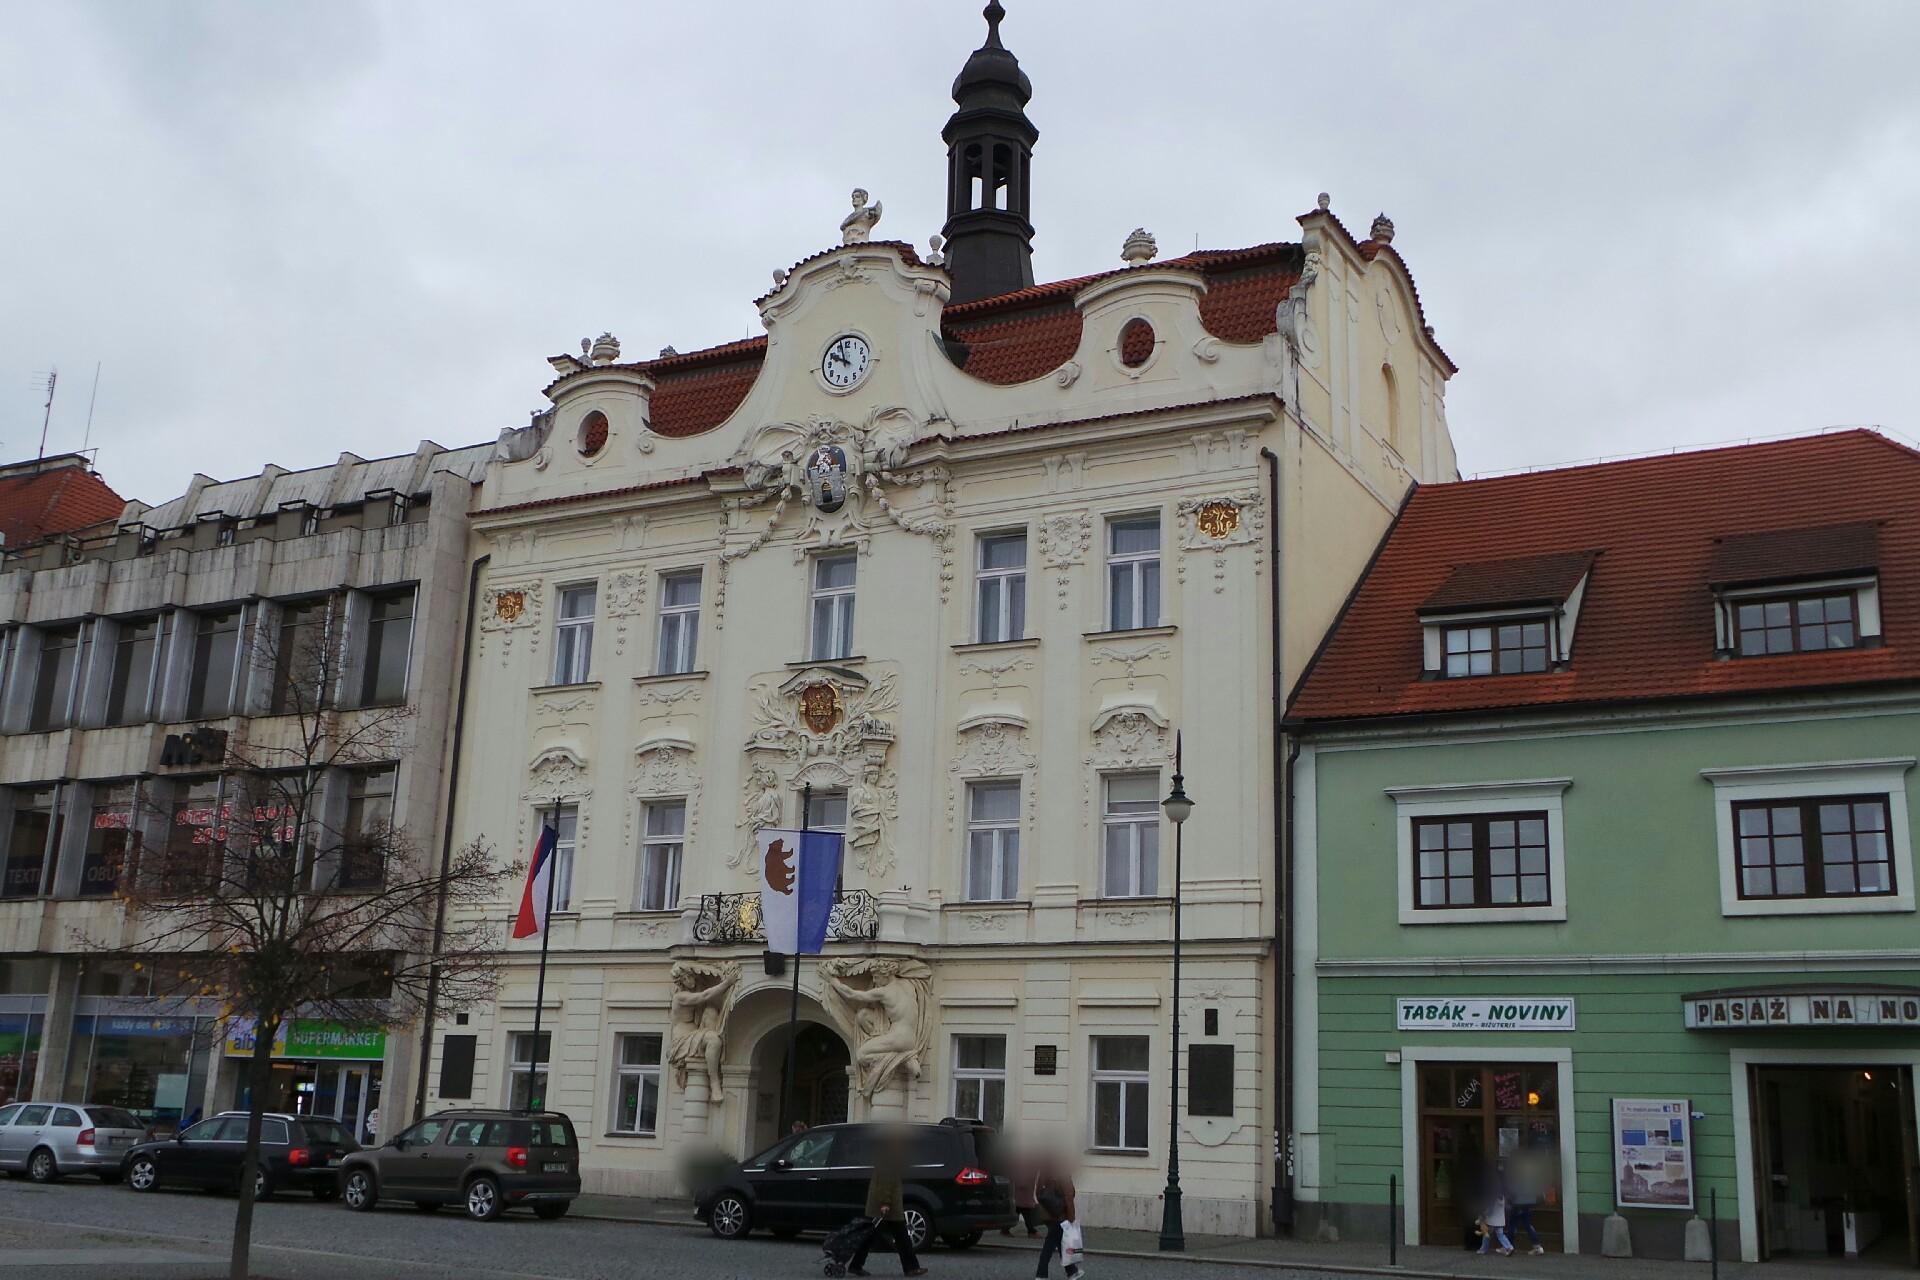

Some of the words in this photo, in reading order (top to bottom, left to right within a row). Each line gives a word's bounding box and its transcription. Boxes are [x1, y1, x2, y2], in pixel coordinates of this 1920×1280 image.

[1402, 1001, 1466, 1021] TABÁK
[1488, 1005, 1568, 1021] NOVINY
[1699, 998, 1785, 1022] PASÁŽ
[1813, 1000, 1853, 1020] NA
[293, 1032, 380, 1048] SUPERMARKET
[1457, 1078, 1481, 1108] SLEVA
